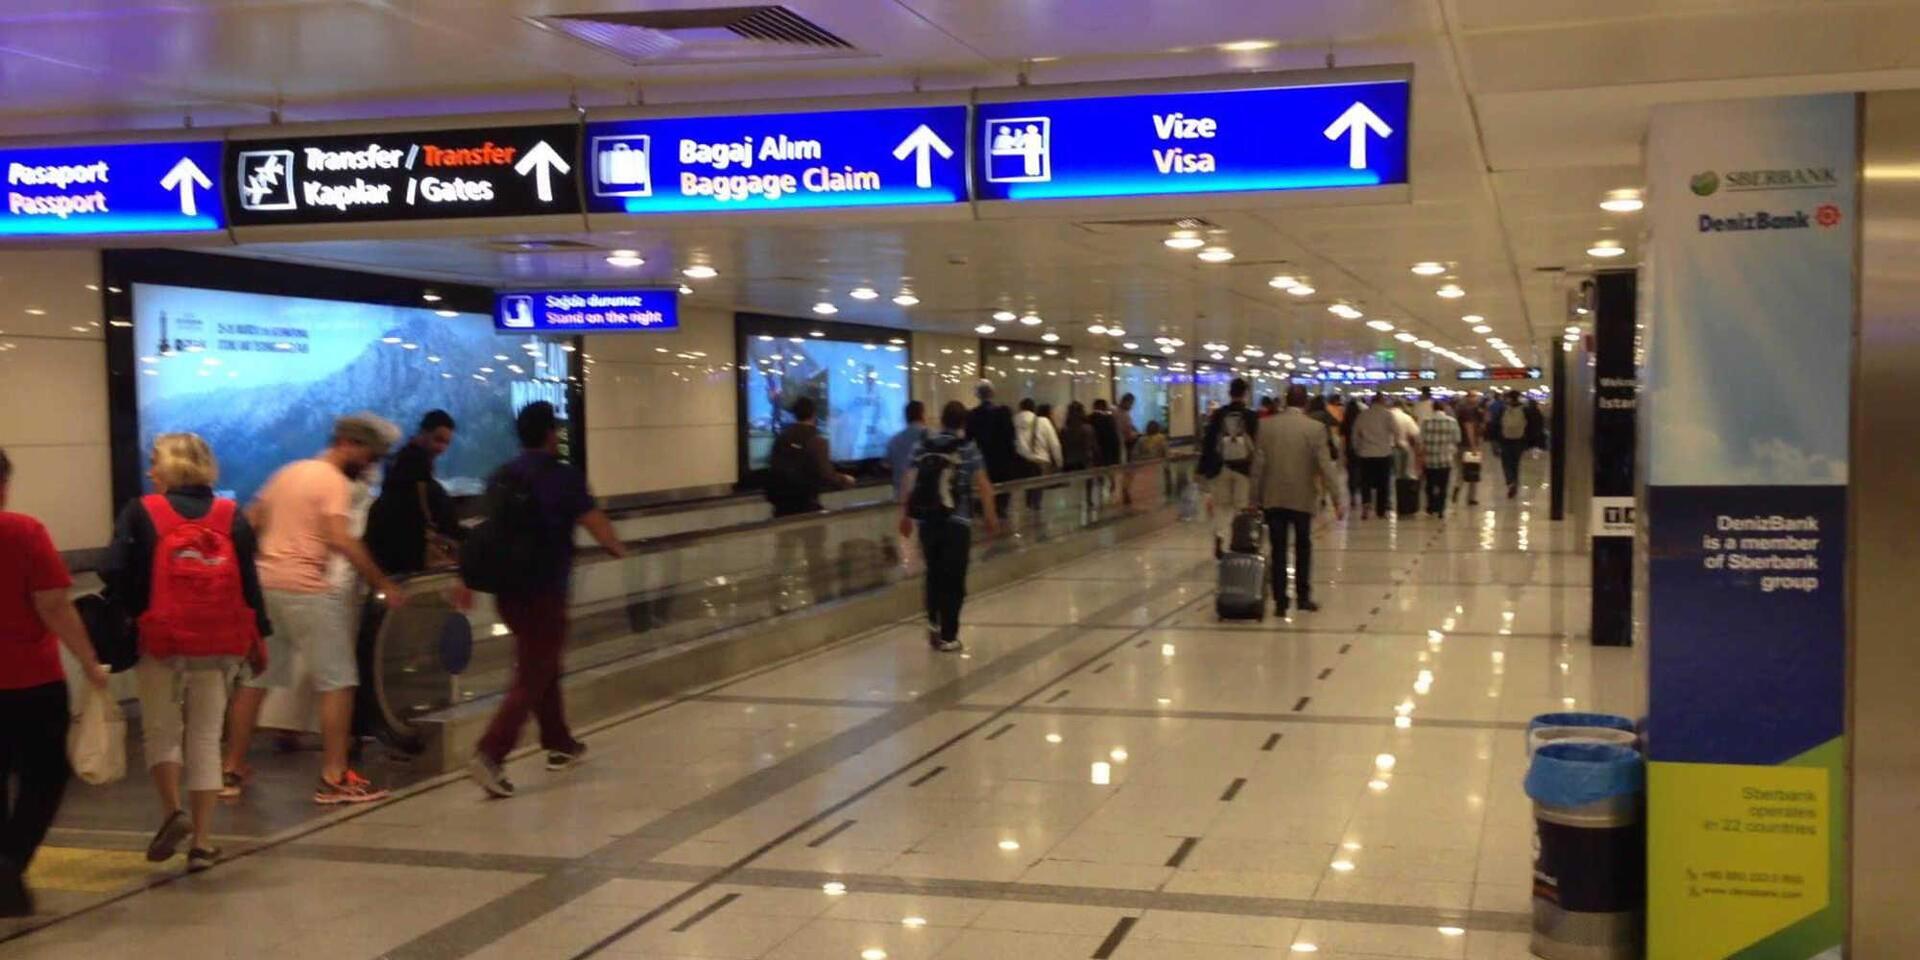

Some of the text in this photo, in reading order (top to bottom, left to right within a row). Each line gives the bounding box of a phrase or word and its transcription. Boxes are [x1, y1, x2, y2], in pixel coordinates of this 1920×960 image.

[1153, 112, 1217, 140] Vize
[304, 144, 404, 172] Transfer
[423, 142, 517, 167] Transfer
[679, 135, 821, 170] Bagaj Alım
[1153, 146, 1216, 174] Visa
[8, 161, 109, 189] Pasaport
[680, 165, 880, 201] Baggage Claim
[1725, 168, 1836, 187] SBERBANK
[420, 175, 493, 204] Gates
[9, 191, 109, 218] Passport
[1699, 211, 1809, 232] DenizBank
[546, 310, 663, 326] Stand on the right
[1716, 515, 1818, 531] DenizBank
[1703, 535, 1819, 550] is a member
[1704, 554, 1818, 569] of Sberbank
[1761, 576, 1818, 592] group
[1721, 819, 1741, 832] 22
